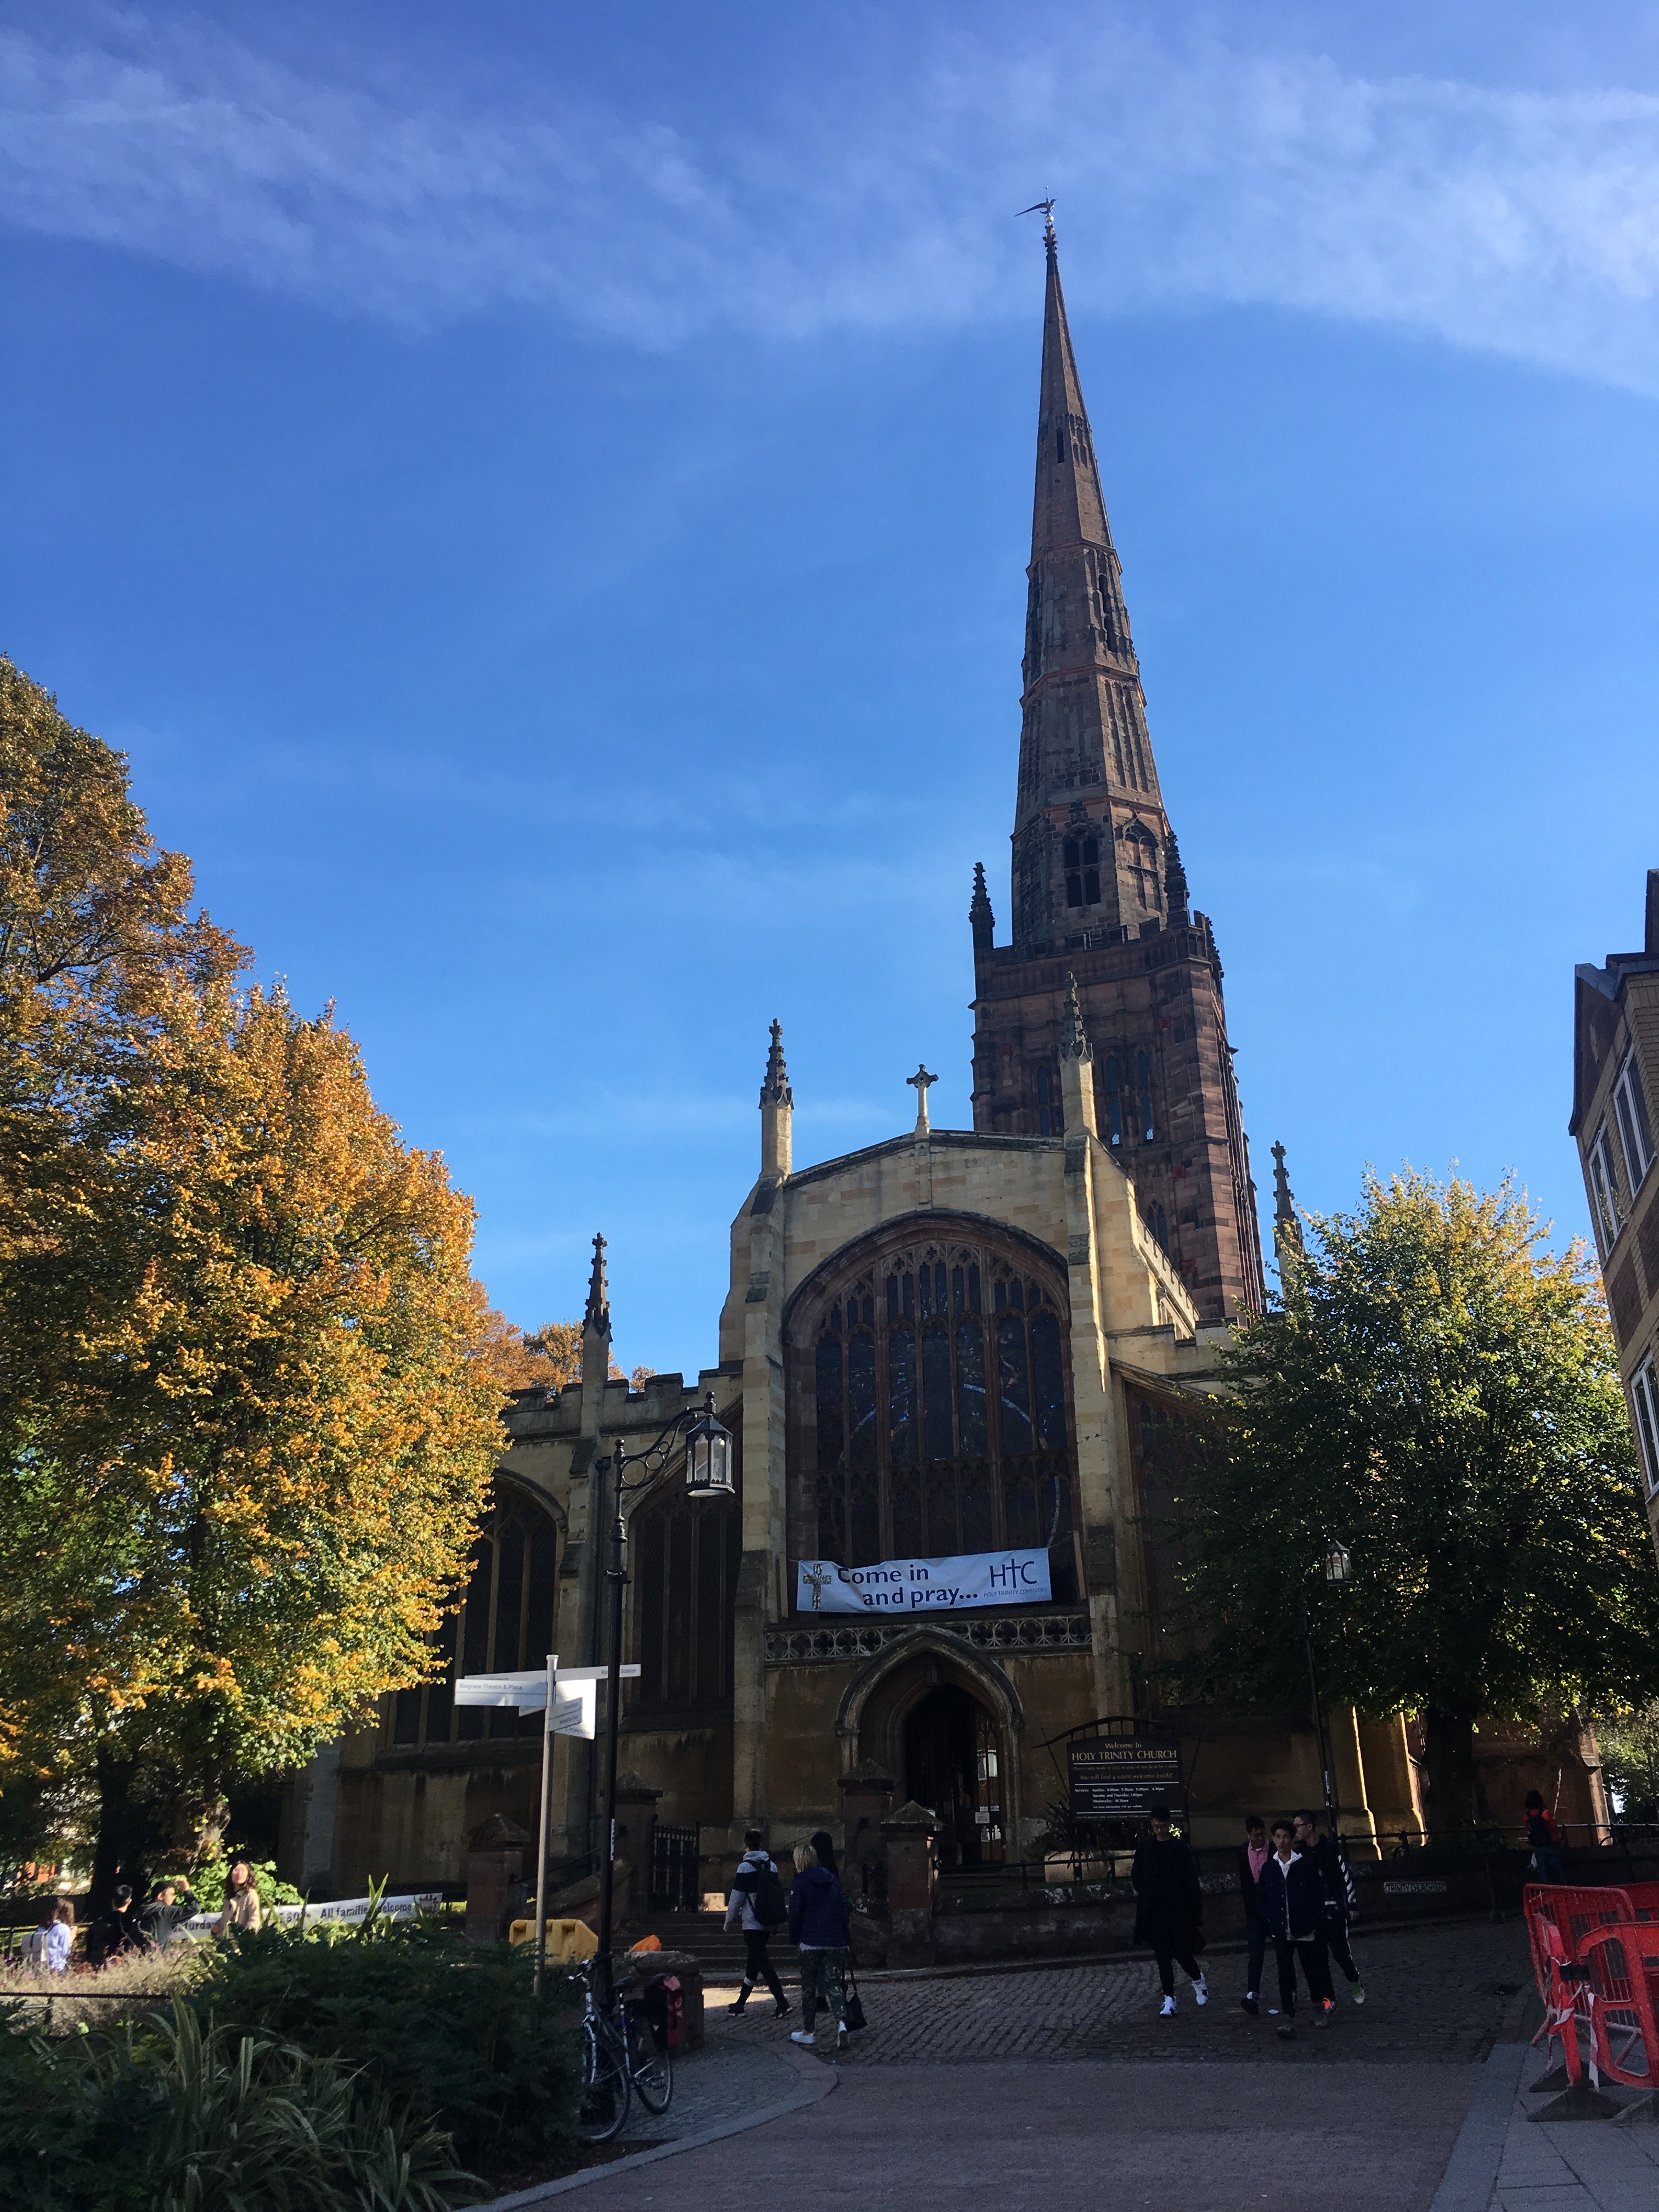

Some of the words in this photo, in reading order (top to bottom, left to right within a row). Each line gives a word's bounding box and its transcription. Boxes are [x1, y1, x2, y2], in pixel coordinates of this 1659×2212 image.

[837, 1567, 902, 1584] Come
[910, 1564, 929, 1581] in
[864, 1587, 904, 1605] and
[911, 1587, 978, 1609] pray...
[1072, 1752, 1096, 1761] HOLY
[1099, 1751, 1134, 1760] TRINITY
[1137, 1750, 1177, 1759] CHURCH
[1387, 1883, 1409, 1893] TRINITY
[320, 1908, 334, 1919] All
[336, 1904, 369, 1917] familie
[381, 1902, 412, 1913] elcome
